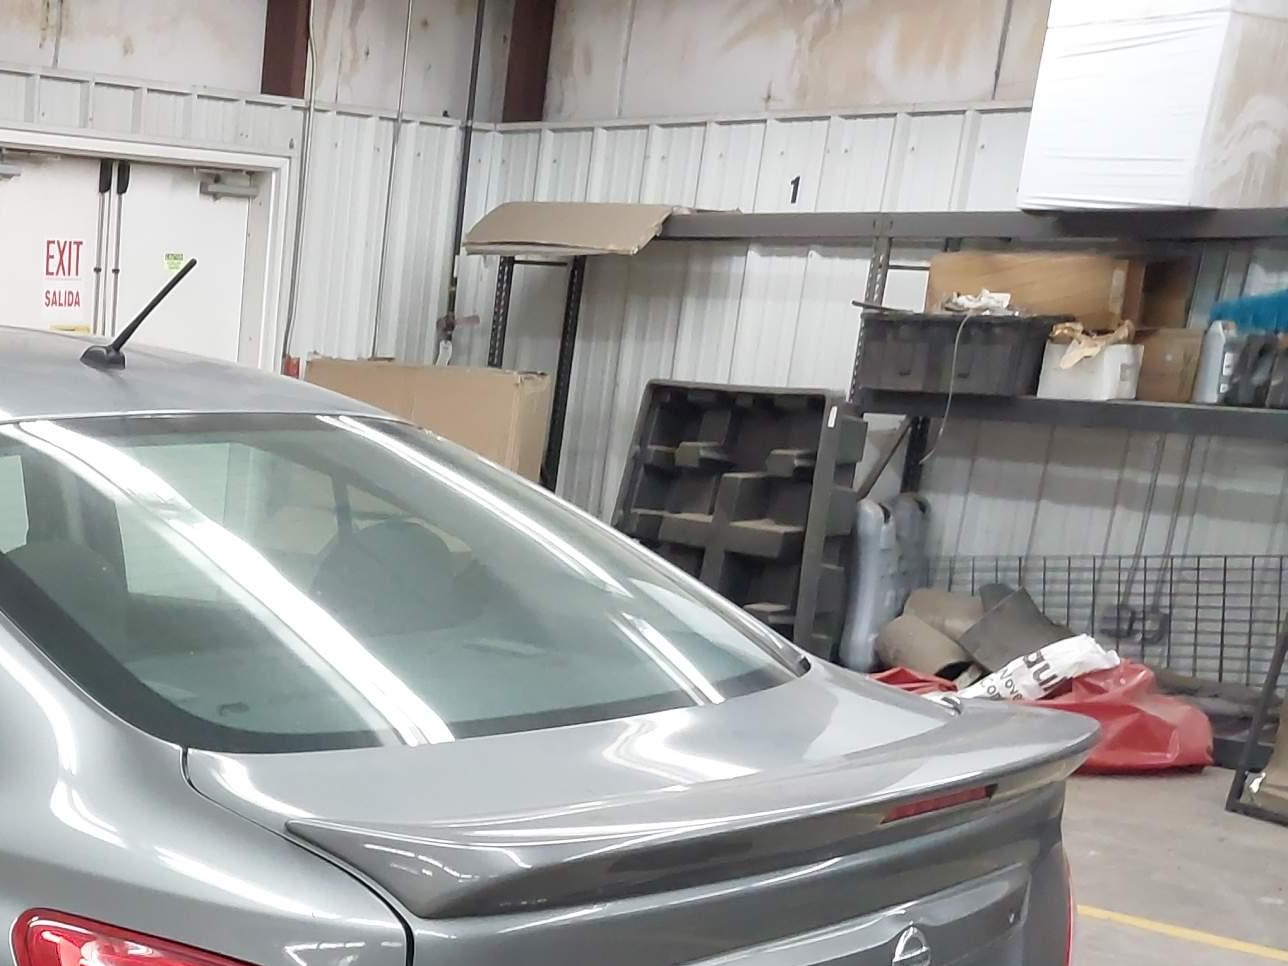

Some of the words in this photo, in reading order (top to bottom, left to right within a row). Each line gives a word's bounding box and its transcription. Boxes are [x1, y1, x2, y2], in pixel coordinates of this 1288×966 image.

[790, 175, 801, 204] 1
[45, 239, 84, 277] EXIT
[44, 289, 81, 308] SALIDA
